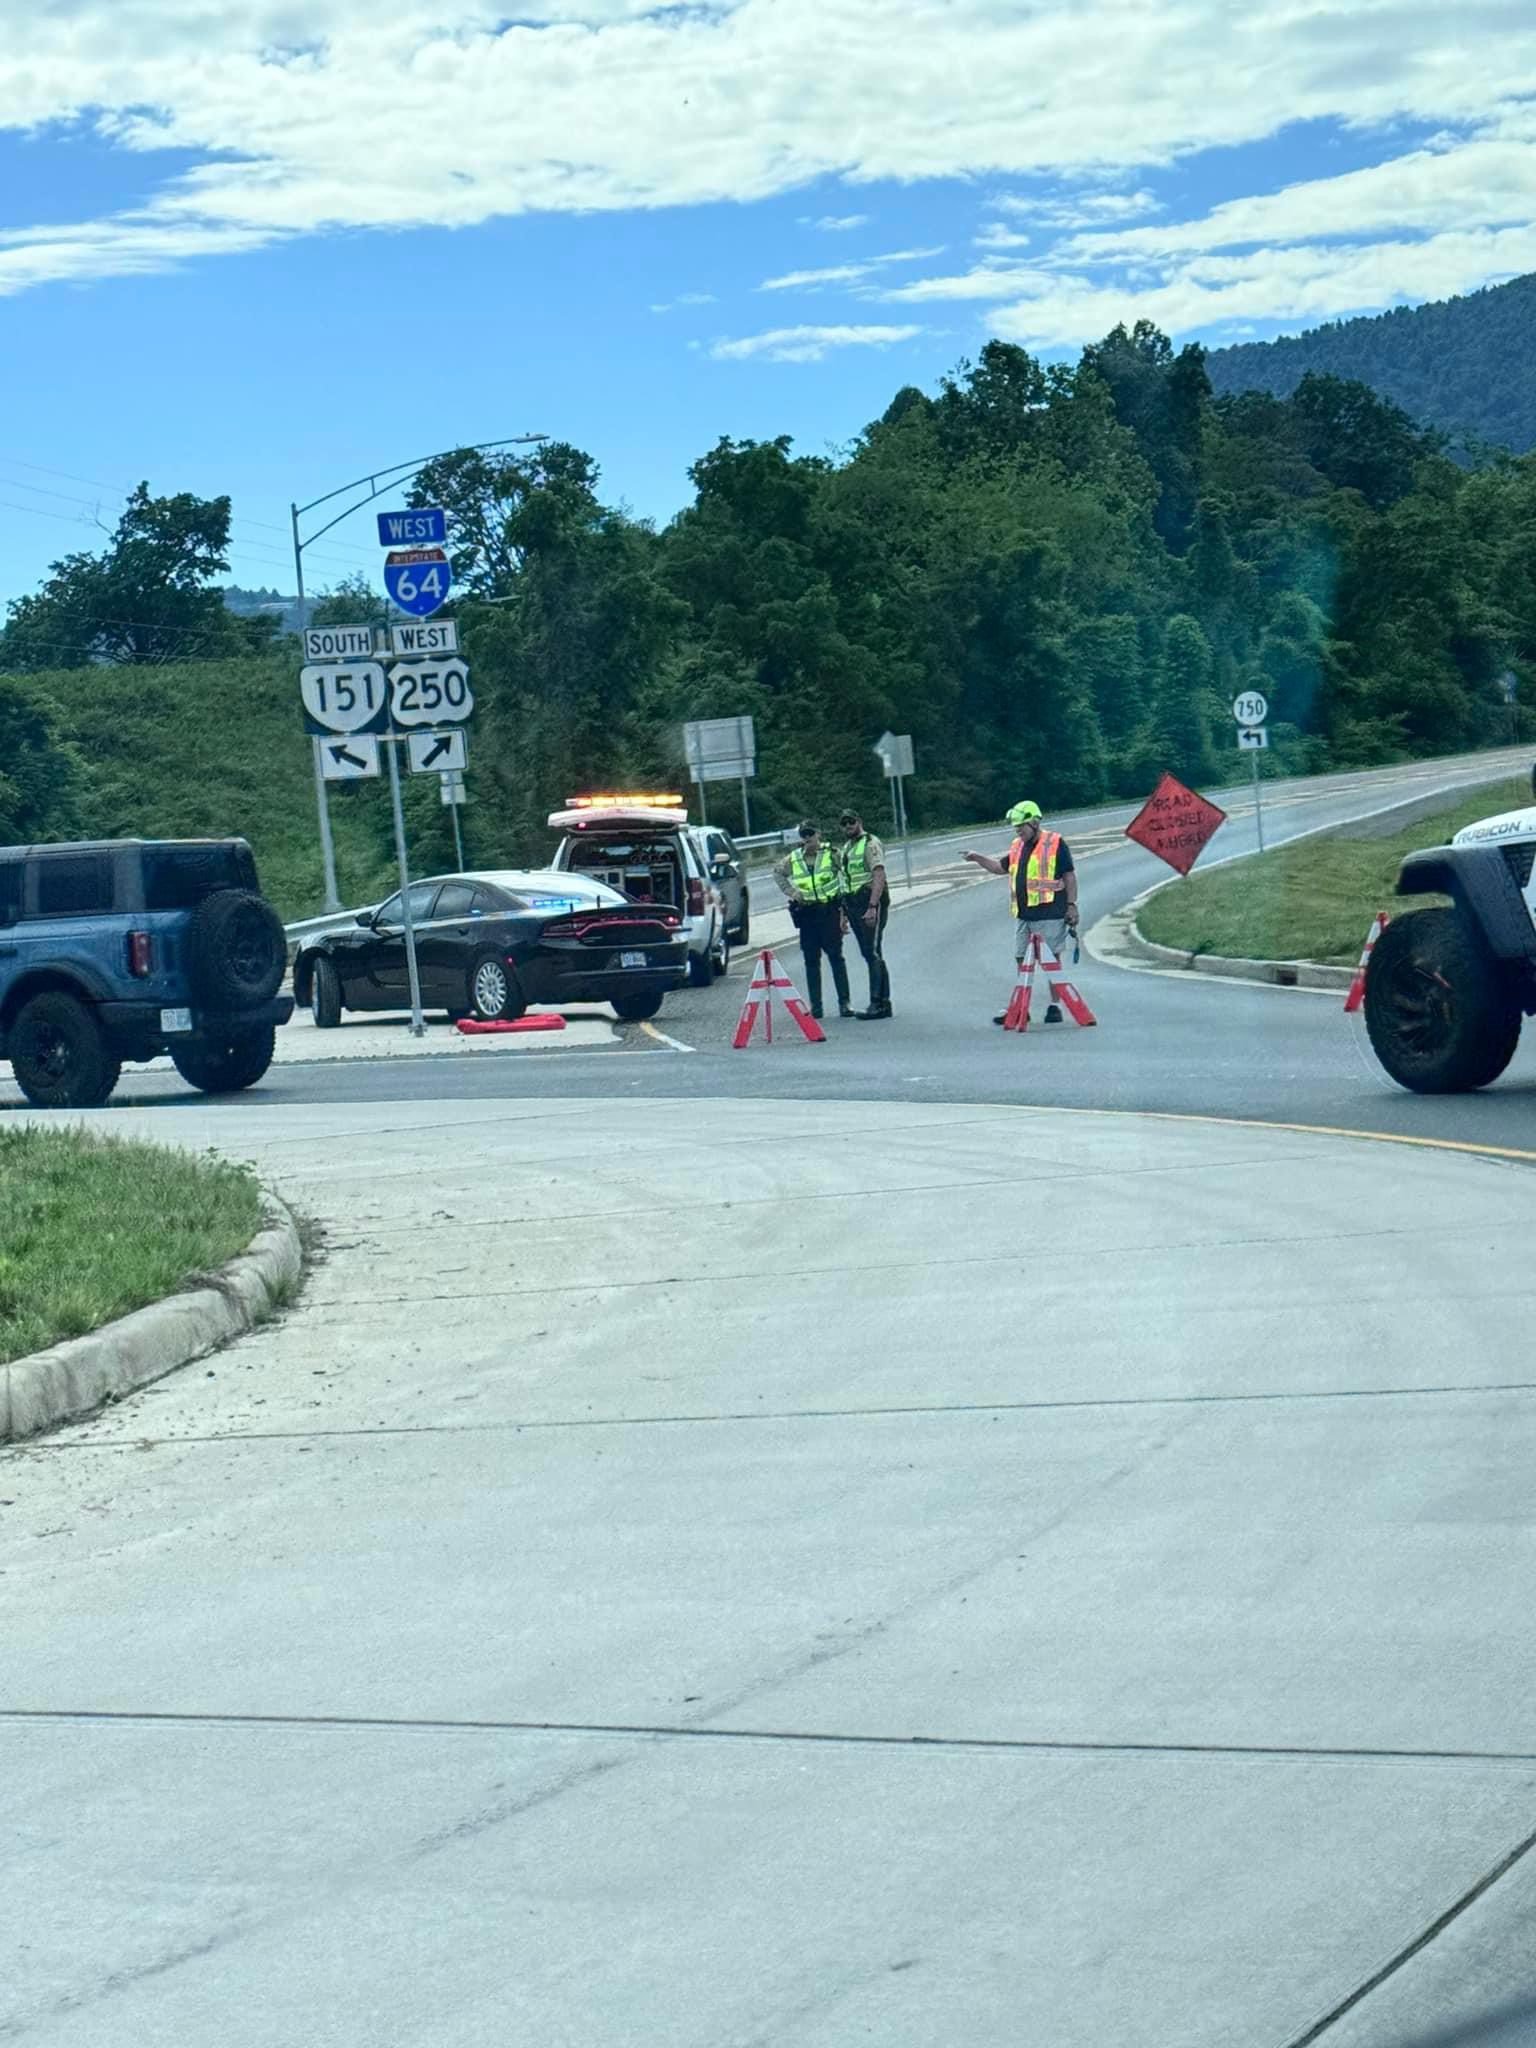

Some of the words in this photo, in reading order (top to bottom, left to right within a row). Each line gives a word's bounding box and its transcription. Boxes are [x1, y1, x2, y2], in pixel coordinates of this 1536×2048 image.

[387, 516, 436, 539] WEST
[396, 567, 443, 602] 64
[309, 633, 370, 656] SOUTH
[400, 627, 449, 650] WEST
[315, 672, 374, 713] 151
[397, 669, 467, 712] 250
[1237, 699, 1264, 718] 750
[1457, 820, 1522, 844] RUBICON
